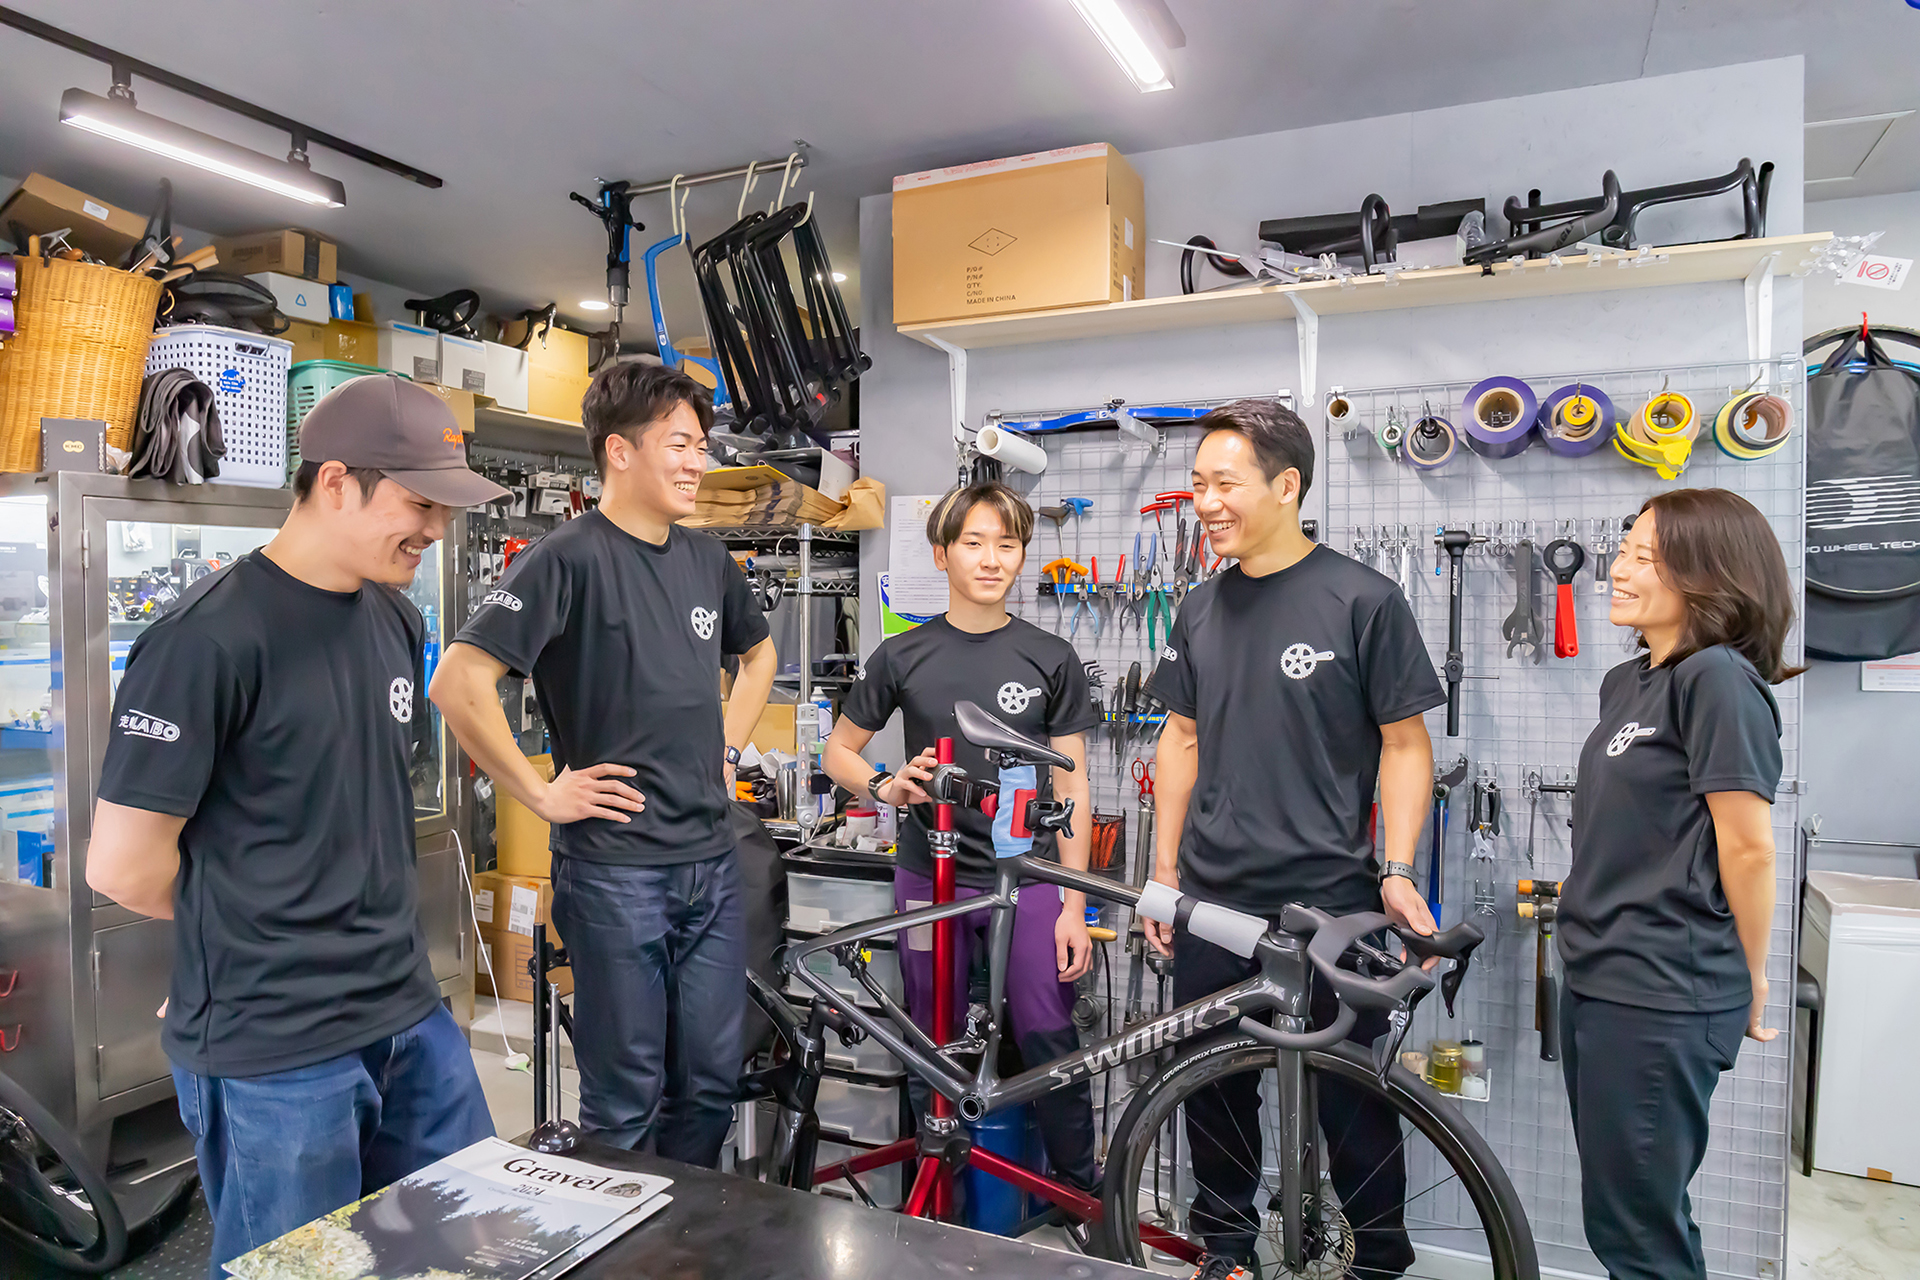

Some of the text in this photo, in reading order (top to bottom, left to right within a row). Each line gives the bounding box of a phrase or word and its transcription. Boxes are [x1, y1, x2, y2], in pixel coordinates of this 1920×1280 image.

[966, 297, 985, 305] MADE
[995, 294, 1017, 302] CHINA
[1823, 542, 1880, 553] WHEEL
[1049, 991, 1240, 1091] S-WORKS
[1162, 1059, 1189, 1082] GRAND
[1189, 1049, 1211, 1064] PRIX
[503, 1158, 614, 1192] Gravel
[511, 1183, 547, 1197] 2024
